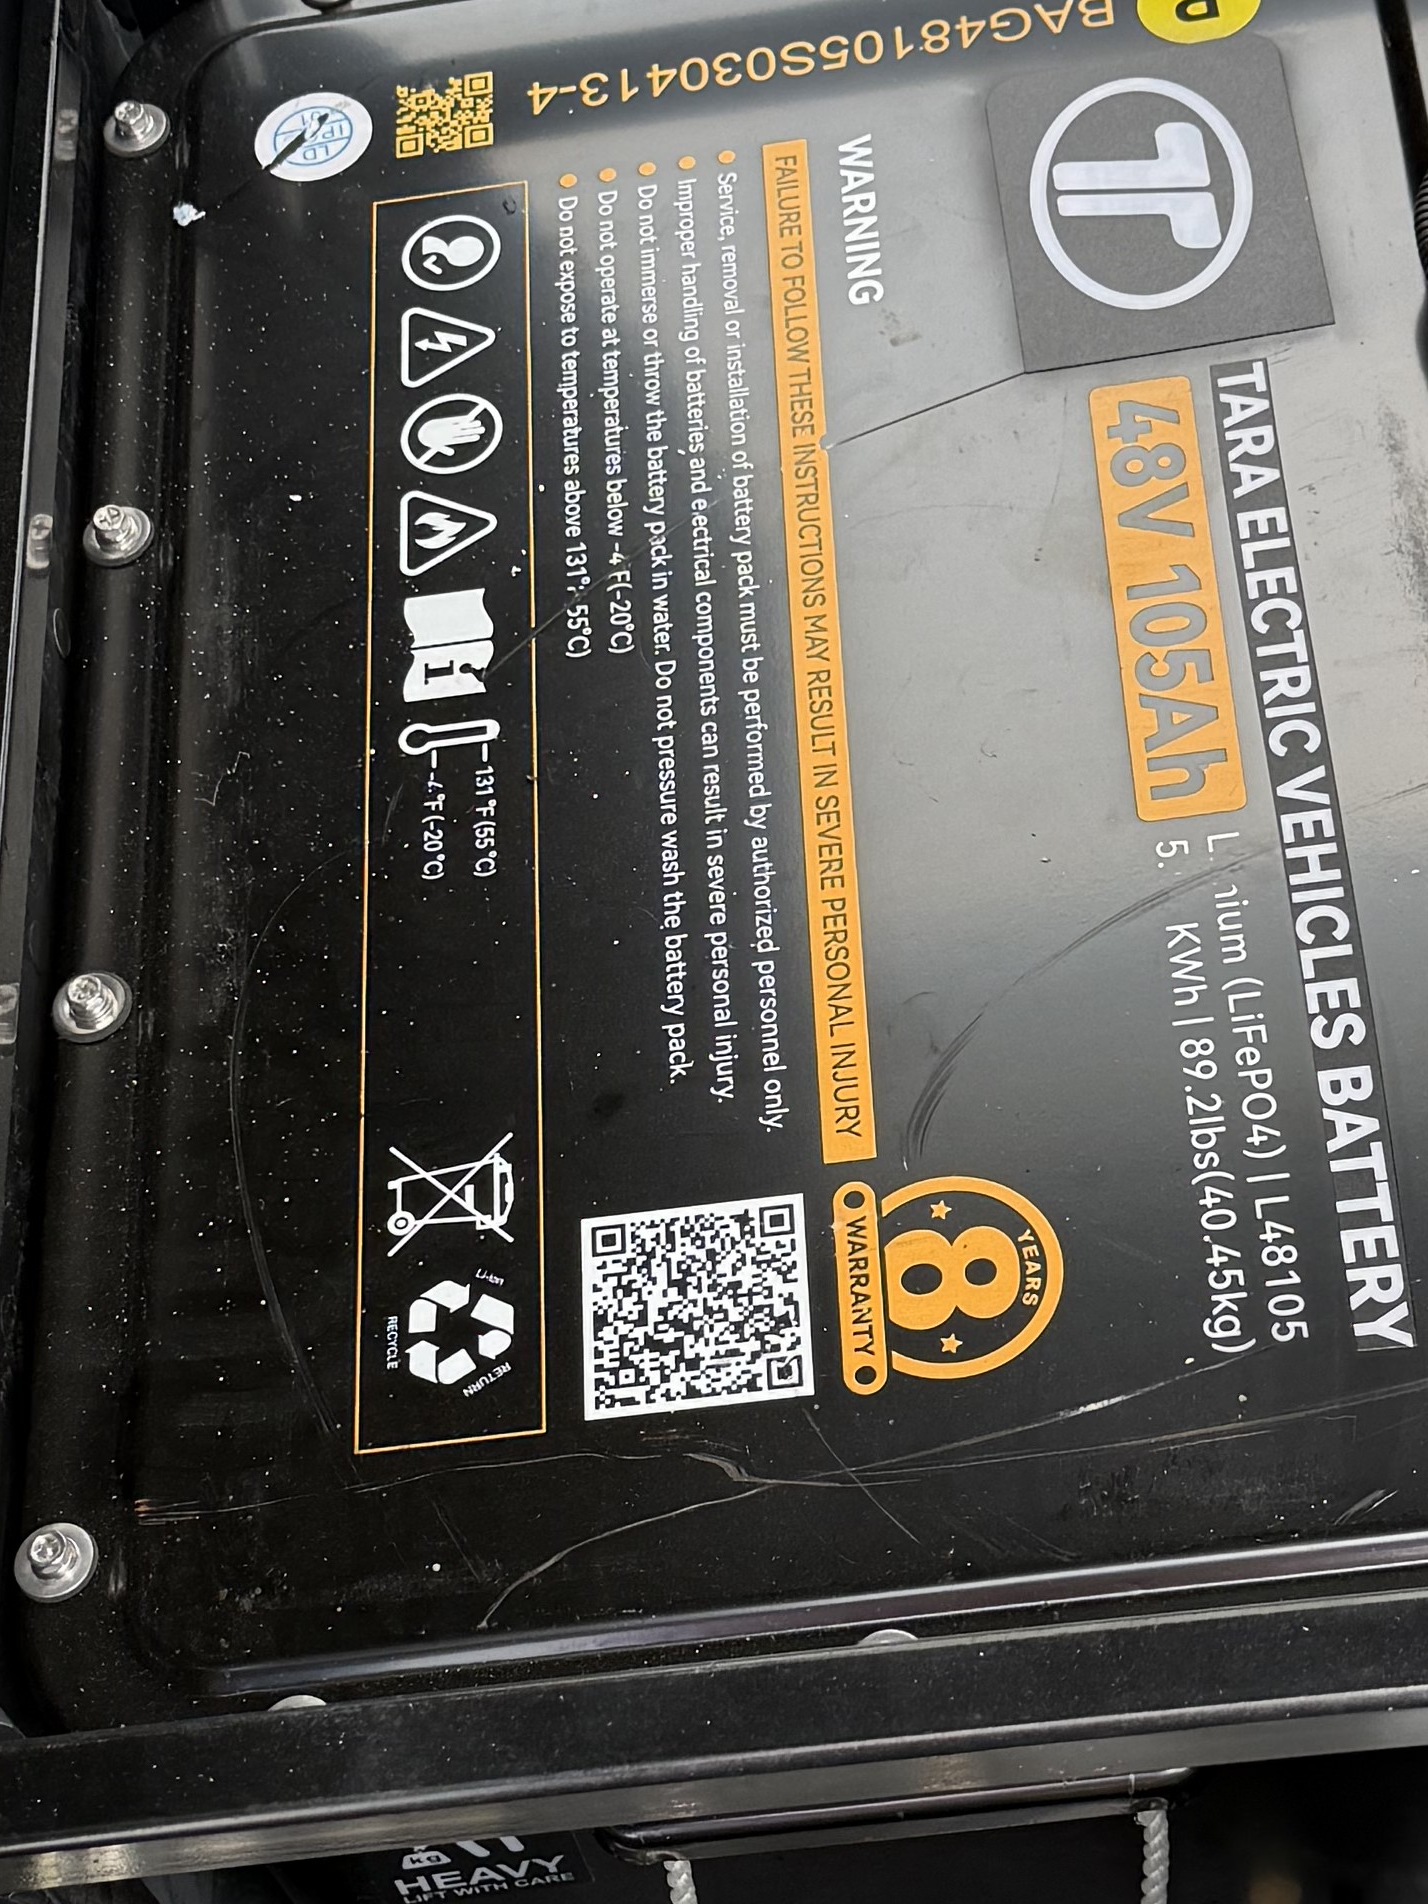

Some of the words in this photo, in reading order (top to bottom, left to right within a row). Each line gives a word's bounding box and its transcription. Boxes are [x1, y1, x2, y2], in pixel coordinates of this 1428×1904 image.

[556, 196, 577, 222] Do
[596, 190, 617, 216] Do
[636, 184, 656, 210] Do
[638, 214, 659, 245] not
[673, 179, 696, 258] Improper
[717, 171, 738, 242] Service,
[774, 155, 801, 238] FAILURE
[837, 134, 883, 306] WARNING
[558, 226, 579, 256] not
[598, 220, 619, 251] not
[779, 241, 803, 270] TO
[554, 260, 578, 323] expose
[594, 255, 621, 323] operate
[640, 248, 660, 323] immerse
[677, 263, 702, 342] handling
[721, 245, 744, 315] removal
[560, 327, 579, 347] to
[601, 328, 621, 347] at
[642, 328, 659, 347] or
[724, 320, 742, 339] or
[781, 275, 809, 363] FOLLOW
[643, 351, 664, 406] throw
[683, 347, 705, 365] of
[556, 350, 584, 475] temperatures
[597, 350, 625, 475] temperatures
[646, 410, 666, 442] the
[684, 370, 707, 453] batteries
[724, 344, 750, 447] installation
[788, 367, 814, 436] THESE
[731, 451, 753, 470] of
[1217, 361, 1279, 499] TARA
[642, 446, 668, 515] battery
[688, 458, 711, 494] and
[1106, 400, 1194, 538] 48V
[563, 480, 586, 537] above
[604, 479, 628, 536] below
[728, 475, 753, 545] battery
[792, 443, 826, 608] INSTRUCTIONS
[643, 521, 672, 568] pack
[730, 550, 759, 598] pack
[564, 541, 591, 658] 131°55°C)
[605, 542, 634, 654] -4F(-20°C)
[651, 571, 672, 590] in
[651, 593, 672, 656] water.
[691, 591, 719, 716] components
[738, 602, 760, 653] must
[802, 614, 830, 662] MAY
[1235, 507, 1321, 757] ELECTRIC
[653, 660, 676, 689] Do
[741, 657, 763, 683] be
[1125, 564, 1227, 800] 105Ah
[655, 695, 677, 731] not
[699, 721, 719, 759] can
[737, 689, 771, 797] performed
[807, 669, 835, 757] RESULT
[651, 735, 678, 826] pressure
[702, 763, 726, 825] result
[812, 764, 837, 788] IN
[704, 829, 727, 849] in
[743, 804, 771, 830] by
[814, 796, 844, 890] SEVERE
[659, 830, 684, 886] wash
[706, 854, 727, 925] severe
[662, 890, 686, 928] the
[750, 836, 780, 952] authorized
[1275, 764, 1365, 1050] VEHICLES
[659, 933, 688, 1015] battery
[703, 932, 737, 1028] personal
[820, 898, 853, 1038] PERSONAL
[751, 960, 786, 1072] personnel
[660, 1023, 693, 1085] pack.
[708, 1034, 738, 1104] injury.
[1220, 976, 1287, 1160] (LiFePO4)
[757, 1079, 789, 1133] only.
[829, 1043, 861, 1138] INJURY
[1179, 1037, 1256, 1355] 89.2lbs(40.45kg)
[1315, 1065, 1414, 1348] BATTERY
[845, 1216, 874, 1356] WARRANTY
[882, 1225, 1020, 1331] 8
[1016, 1228, 1040, 1307] YEARS
[1253, 1195, 1308, 1344] L48105
[385, 1315, 397, 1370] RECYCLE
[461, 1362, 511, 1398] RETURN
[394, 1855, 565, 1896] HEAVY
[403, 1890, 447, 1904] LIFT
[453, 1882, 509, 1897] WITH
[515, 1872, 576, 1889] CARE
[409, 1852, 441, 1865] kg
